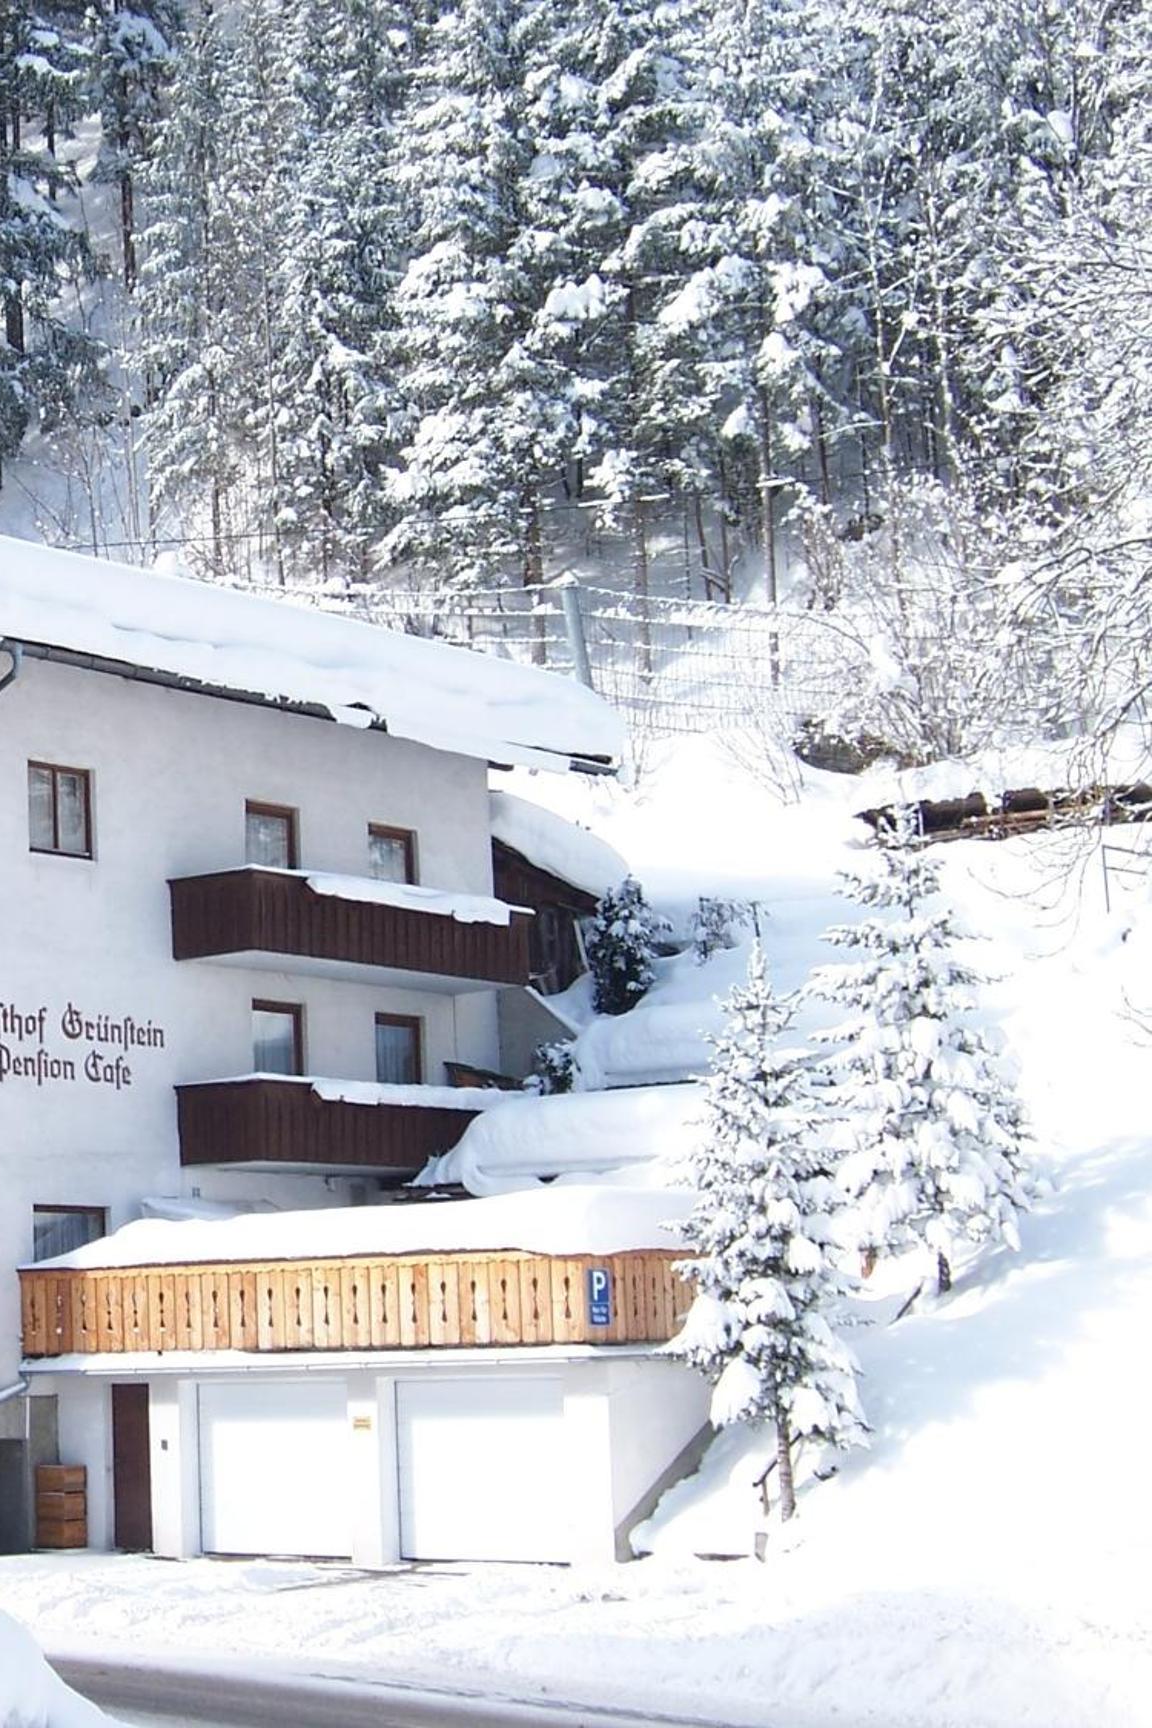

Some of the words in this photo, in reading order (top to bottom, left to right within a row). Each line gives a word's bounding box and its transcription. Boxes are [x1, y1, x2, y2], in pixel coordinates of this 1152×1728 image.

[61, 1001, 165, 1051] Grünstein
[84, 1050, 132, 1090] Cafe
[592, 1271, 606, 1301] P
